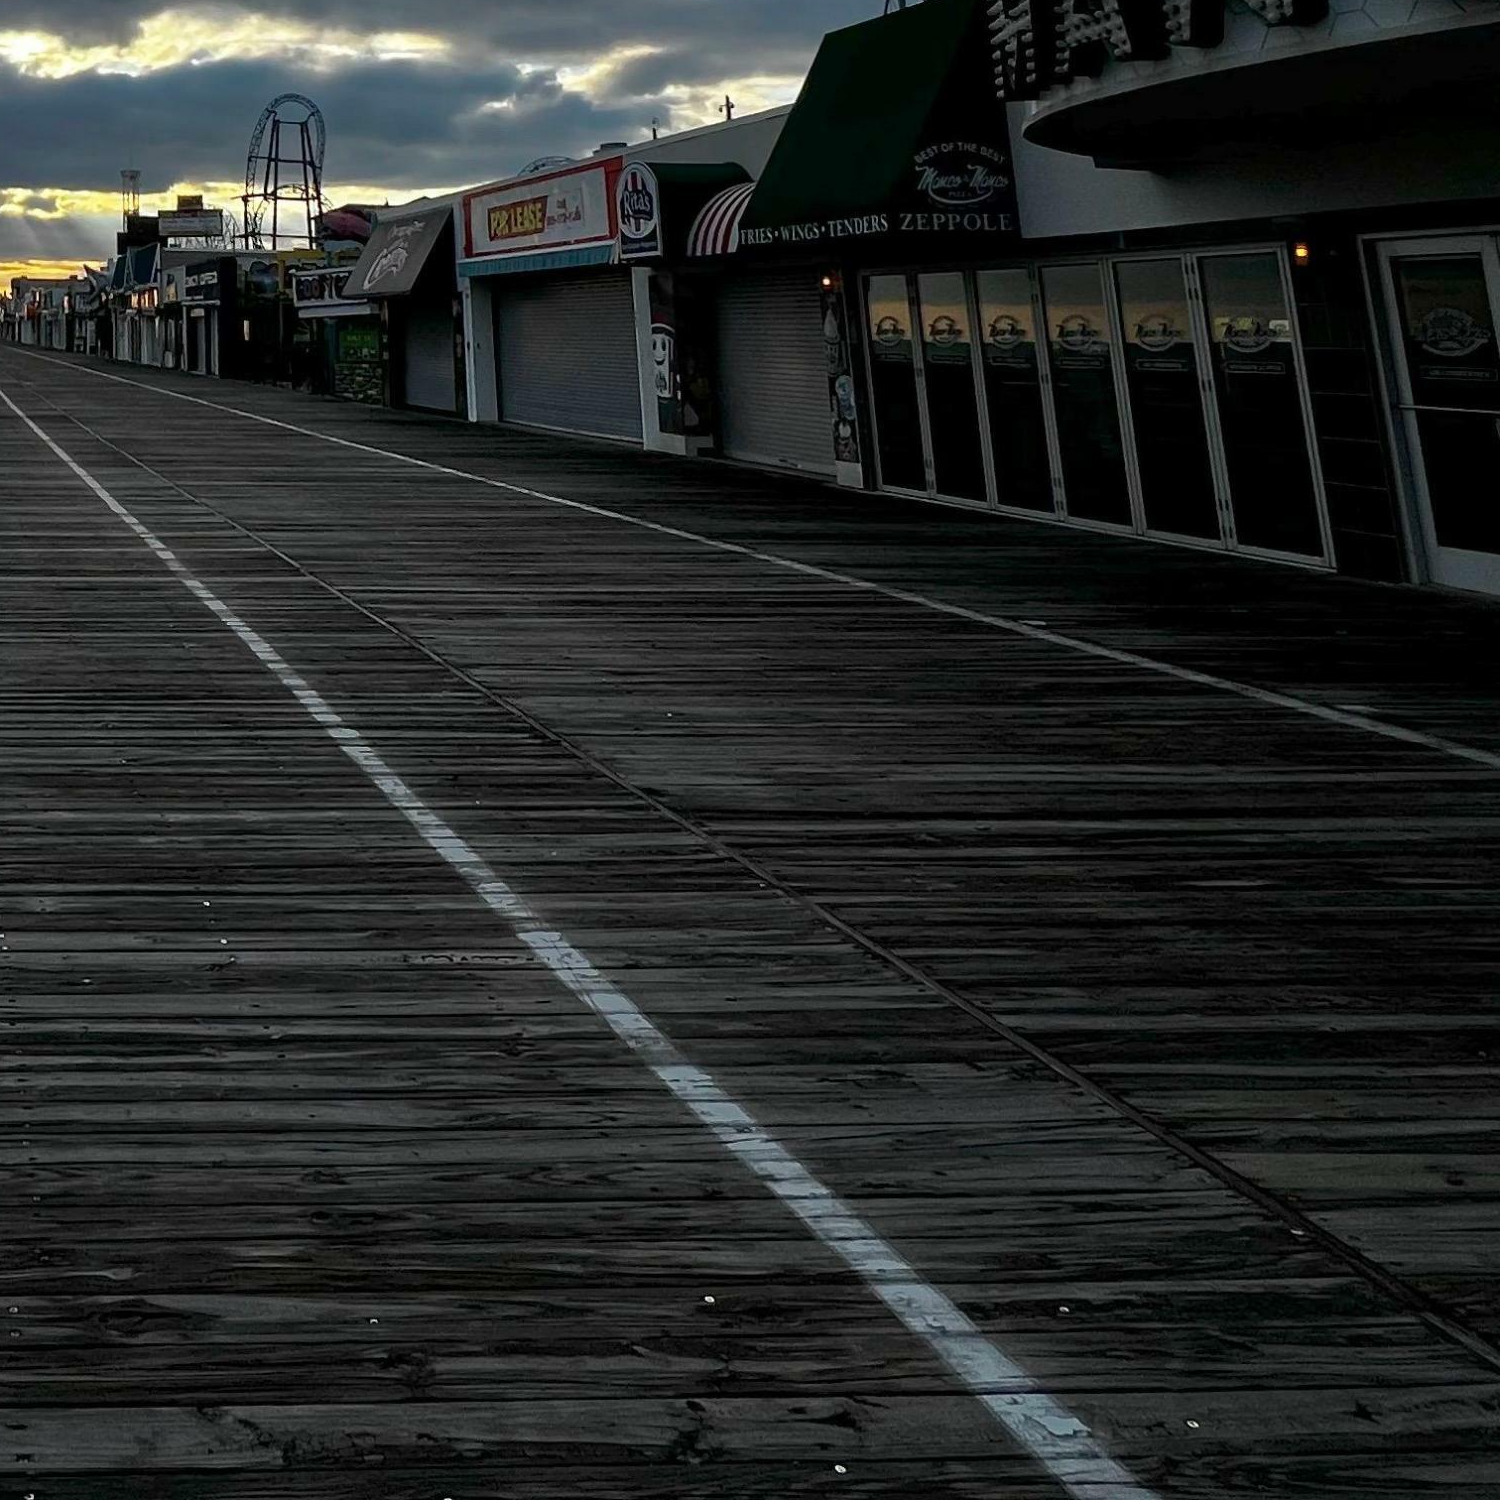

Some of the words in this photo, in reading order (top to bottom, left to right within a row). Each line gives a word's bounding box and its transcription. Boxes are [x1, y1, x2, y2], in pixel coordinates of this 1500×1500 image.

[940, 142, 954, 153] OF
[955, 142, 978, 153] THE
[510, 202, 543, 233] LEASE
[740, 226, 773, 245] FRIES
[780, 221, 821, 242] WINGS
[827, 212, 889, 238] TENDERS
[899, 212, 1013, 232] ZEPPOLE
